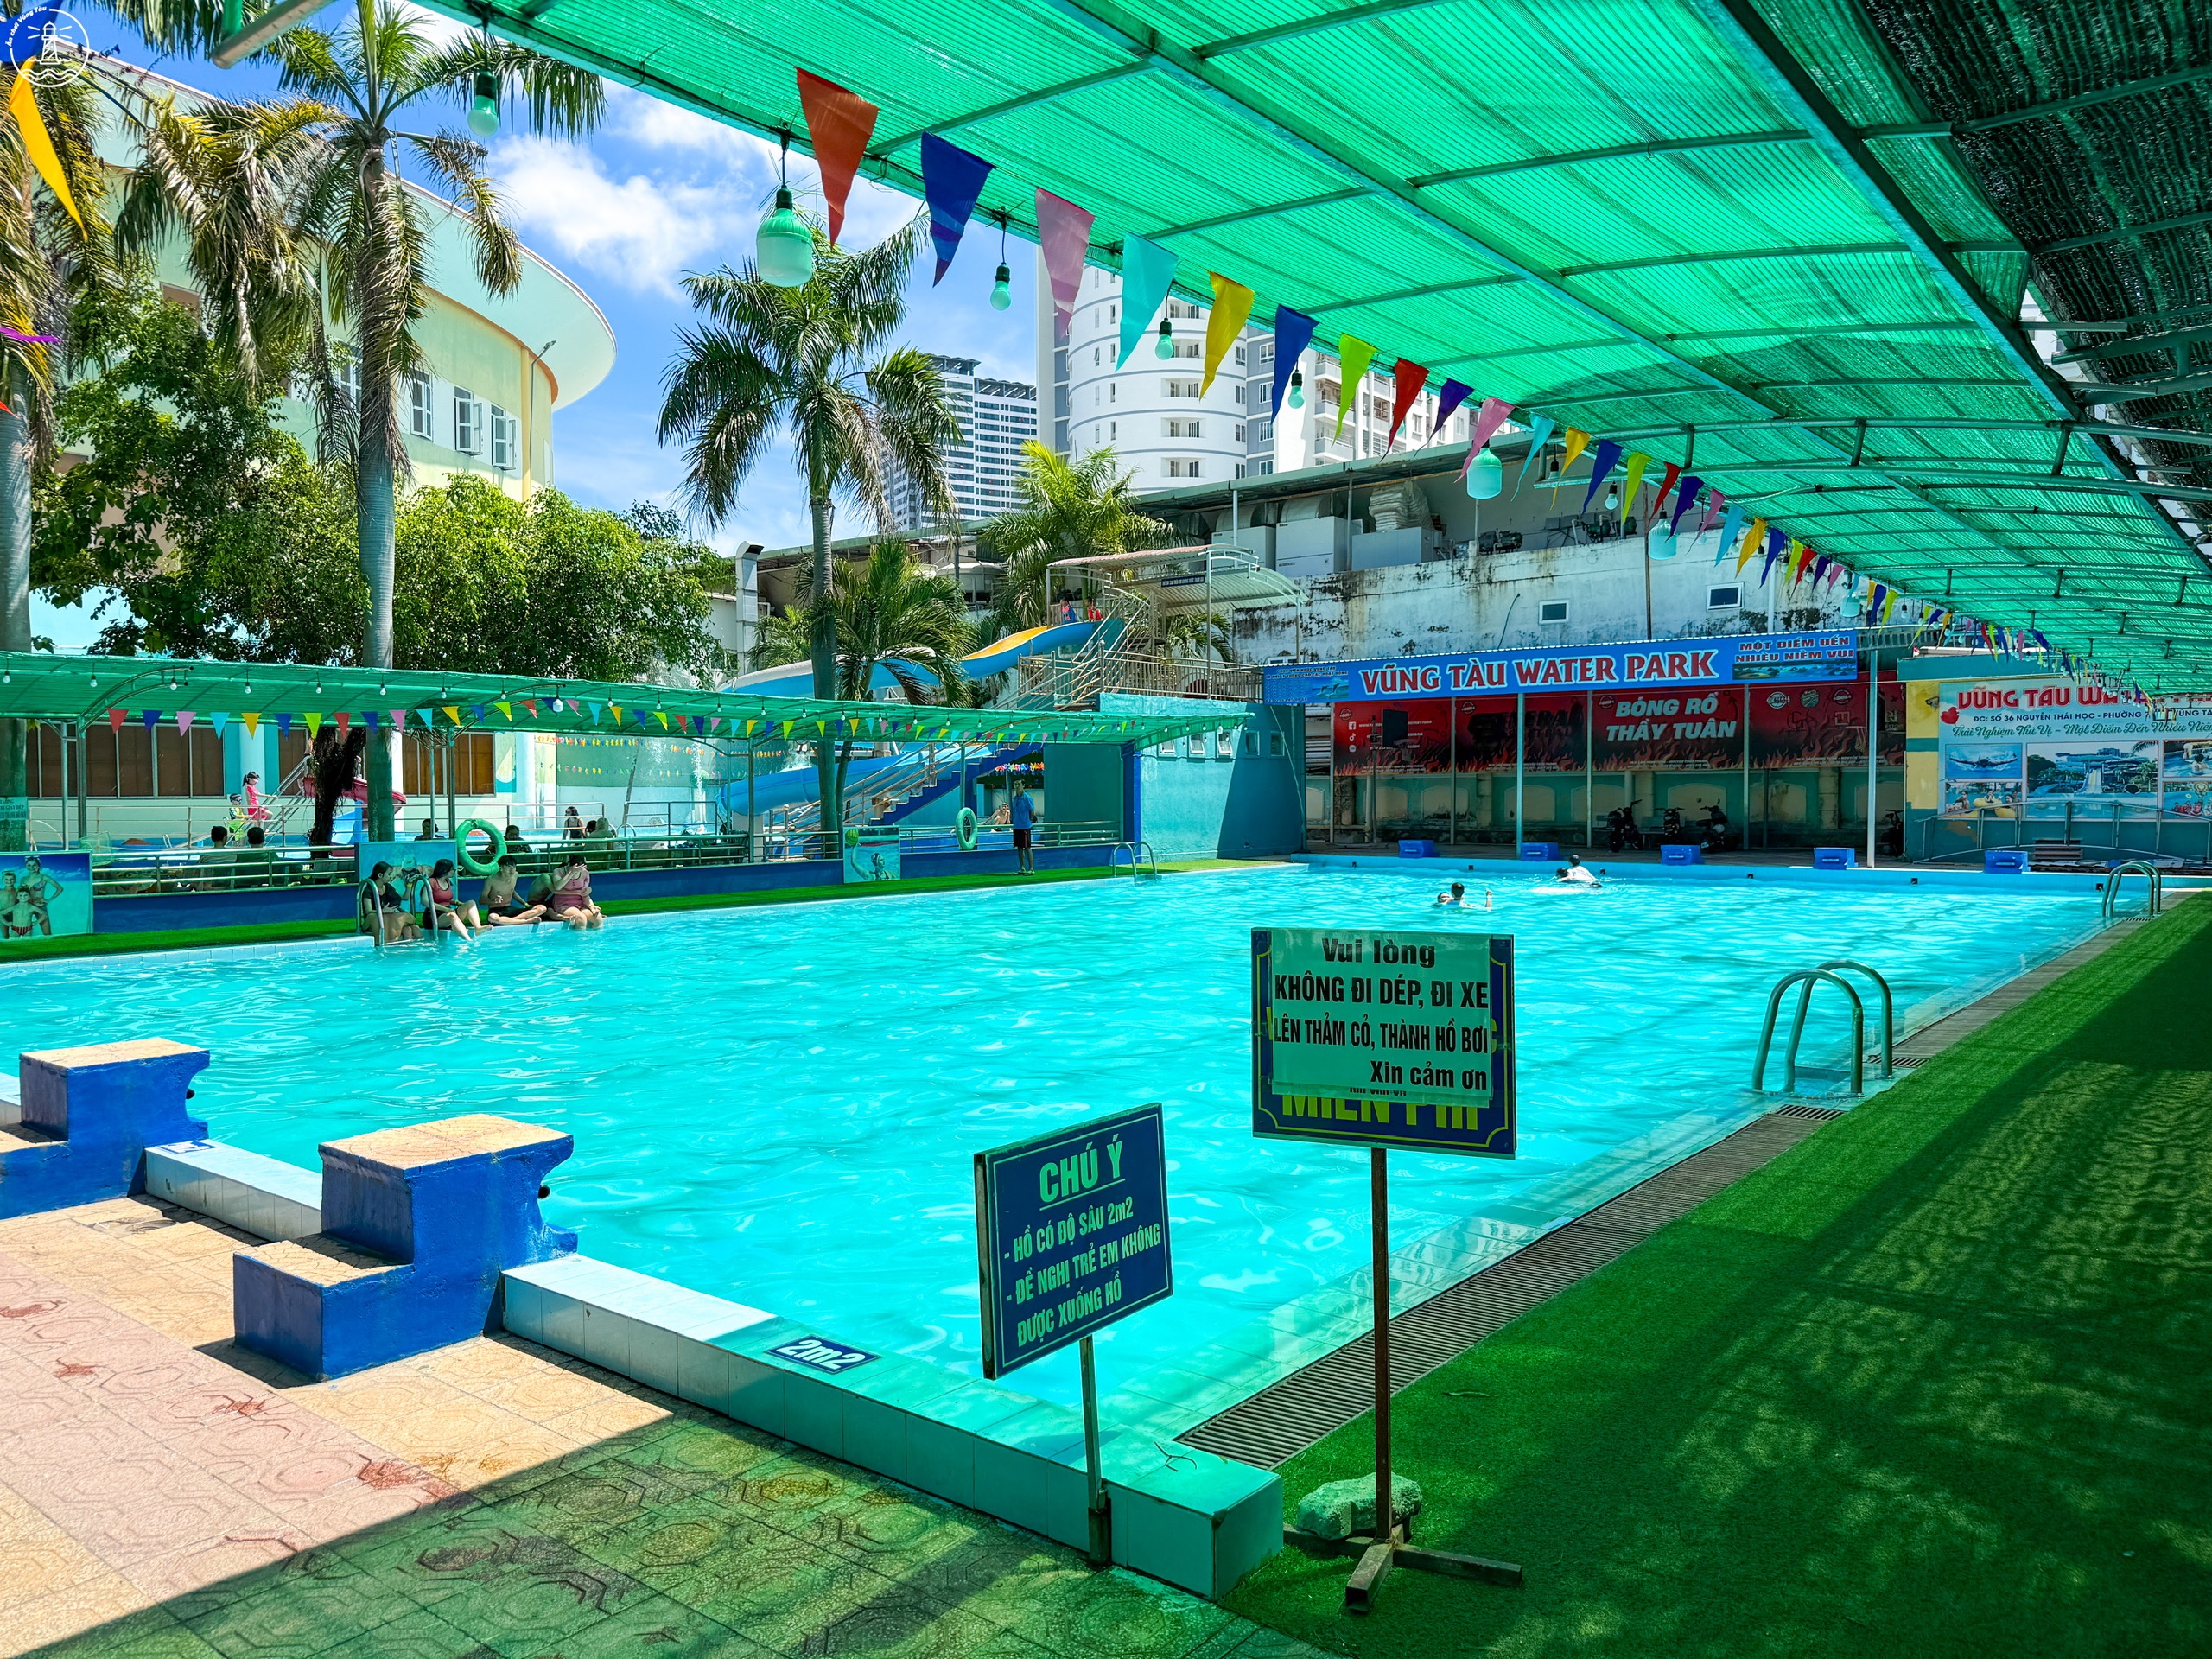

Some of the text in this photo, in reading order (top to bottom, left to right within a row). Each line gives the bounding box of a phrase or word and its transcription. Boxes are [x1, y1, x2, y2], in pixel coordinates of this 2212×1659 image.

[1735, 649, 1853, 663] NHIỀU NIỀM VUI
[1739, 634, 1850, 652] MỘT ĐIỂM ĐẾN
[1360, 649, 1719, 695] VŨNG TÀU WATER PARK
[1615, 696, 1680, 717] BÓNG
[1957, 685, 2018, 709] VŨNG
[2023, 685, 2072, 708] TÀU
[1606, 718, 1668, 741] THẦY
[1975, 725, 2015, 740] Nghiệm
[2037, 724, 2052, 737] Vị
[2063, 723, 2089, 737] Một
[1991, 713, 2002, 721] SỐ
[2017, 712, 2050, 721] NGUYỄN
[2053, 711, 2073, 720] THÁI
[1322, 937, 1435, 969] Vui lòng
[1274, 970, 1489, 1009] KHÔNG ĐI DÉP, ĐI XE
[1274, 1013, 1300, 1043] LÊN
[1305, 1012, 1345, 1046] THẢM
[1351, 1014, 1376, 1051] CỎ,
[1380, 1018, 1430, 1051] THÀNH
[1435, 1018, 1456, 1052] HỒ
[1461, 1025, 1488, 1054] BƠI
[1370, 1060, 1487, 1090] Xin cảm ơn
[1039, 1133, 1123, 1203] CHÚ Ý
[1014, 1224, 1033, 1262] HỒ
[1037, 1219, 1055, 1253] CÓ
[1058, 1212, 1076, 1246] ĐỘ
[1079, 1205, 1104, 1236] SÂU
[1108, 1196, 1134, 1226] 2m2
[1015, 1266, 1034, 1305] ĐỀ
[1038, 1259, 1070, 1295] NGHỊ
[1072, 1242, 1096, 1279] TRẺ
[1099, 1240, 1119, 1268] EM
[1122, 1223, 1161, 1259] KHÔNG
[1018, 1270, 1122, 1347] ĐƯỢC XUỐNG HỒ
[776, 1339, 866, 1370] 2m2
